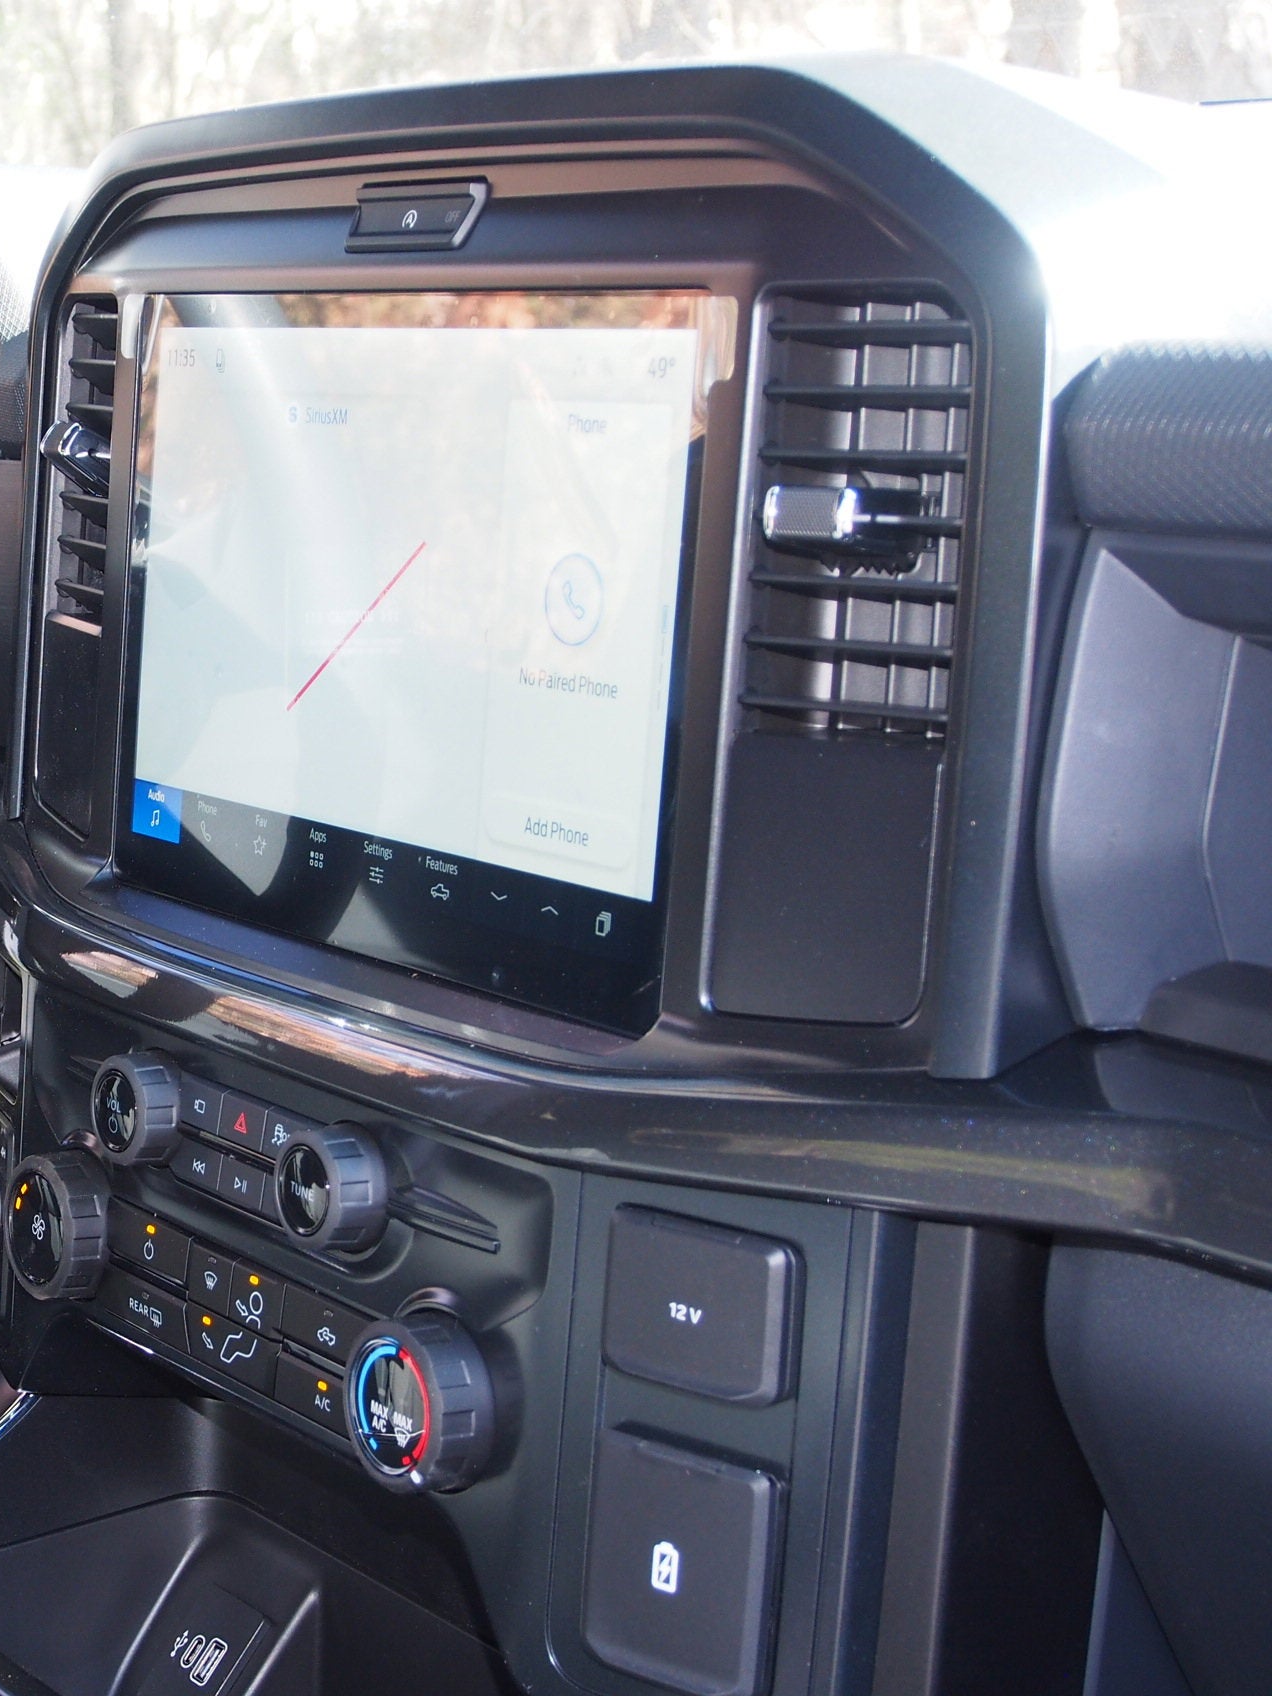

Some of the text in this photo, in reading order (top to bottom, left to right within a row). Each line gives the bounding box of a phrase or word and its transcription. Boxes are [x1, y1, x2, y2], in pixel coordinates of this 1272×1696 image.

[167, 349, 196, 367] 11:35
[305, 406, 348, 427] SiriusXM
[567, 413, 608, 435] Phone
[519, 668, 618, 701] No Paired Phone
[148, 788, 166, 803] Audio
[197, 800, 218, 816] Phone
[256, 814, 268, 828] Fav
[309, 827, 327, 843] Apps
[524, 816, 589, 847] Add Phone
[364, 841, 393, 861] Settings
[426, 856, 459, 876] Features
[106, 1097, 121, 1113] VOL
[290, 1180, 315, 1202] TUNE
[129, 1296, 148, 1316] REAR
[315, 1394, 331, 1413] A/C
[370, 1399, 389, 1421] MAX
[372, 1417, 387, 1433] A/C
[393, 1411, 413, 1432] MAX
